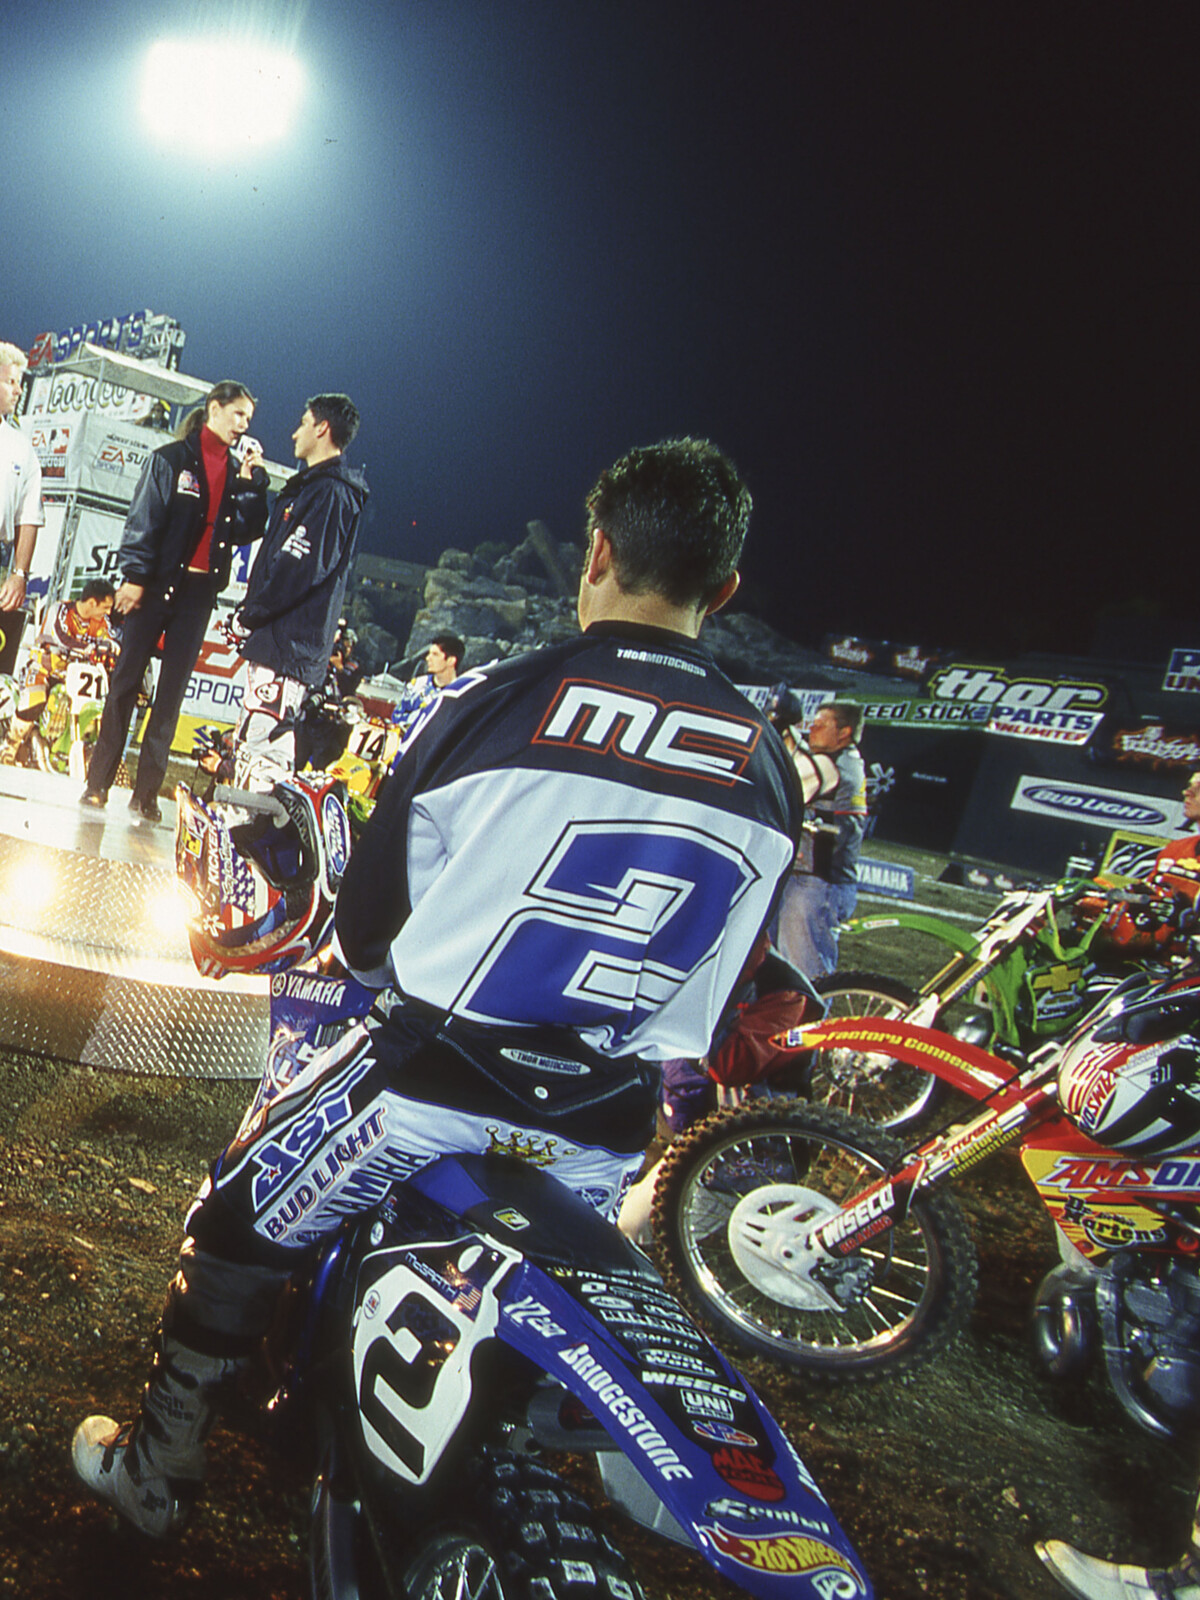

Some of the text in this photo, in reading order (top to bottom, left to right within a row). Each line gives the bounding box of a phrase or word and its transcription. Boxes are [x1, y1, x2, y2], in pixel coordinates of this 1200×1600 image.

[28, 310, 148, 368] EA SPORTS
[101, 445, 125, 467] EA
[78, 671, 103, 700] 21
[184, 675, 246, 708] SPOR
[934, 668, 1102, 709] thor
[987, 720, 1090, 742] UNLIMITED
[992, 706, 1094, 731] PARTS
[357, 729, 389, 762] 14
[1030, 789, 1155, 820] BUD LIGHT
[208, 824, 220, 886] KICKER
[855, 864, 909, 893] YAMAHA
[446, 818, 763, 1048] 2
[285, 974, 347, 1008] YAMAHA
[264, 1106, 386, 1241] BUD LIGHT
[314, 1145, 441, 1220] YAMAHA
[822, 1183, 896, 1248] WISECO
[839, 1214, 894, 1255] BRAKING
[356, 1284, 466, 1484] 2
[641, 1371, 747, 1403] WISECO
[557, 1343, 694, 1482] BRIDGESTONE
[685, 1391, 729, 1413] UNI
